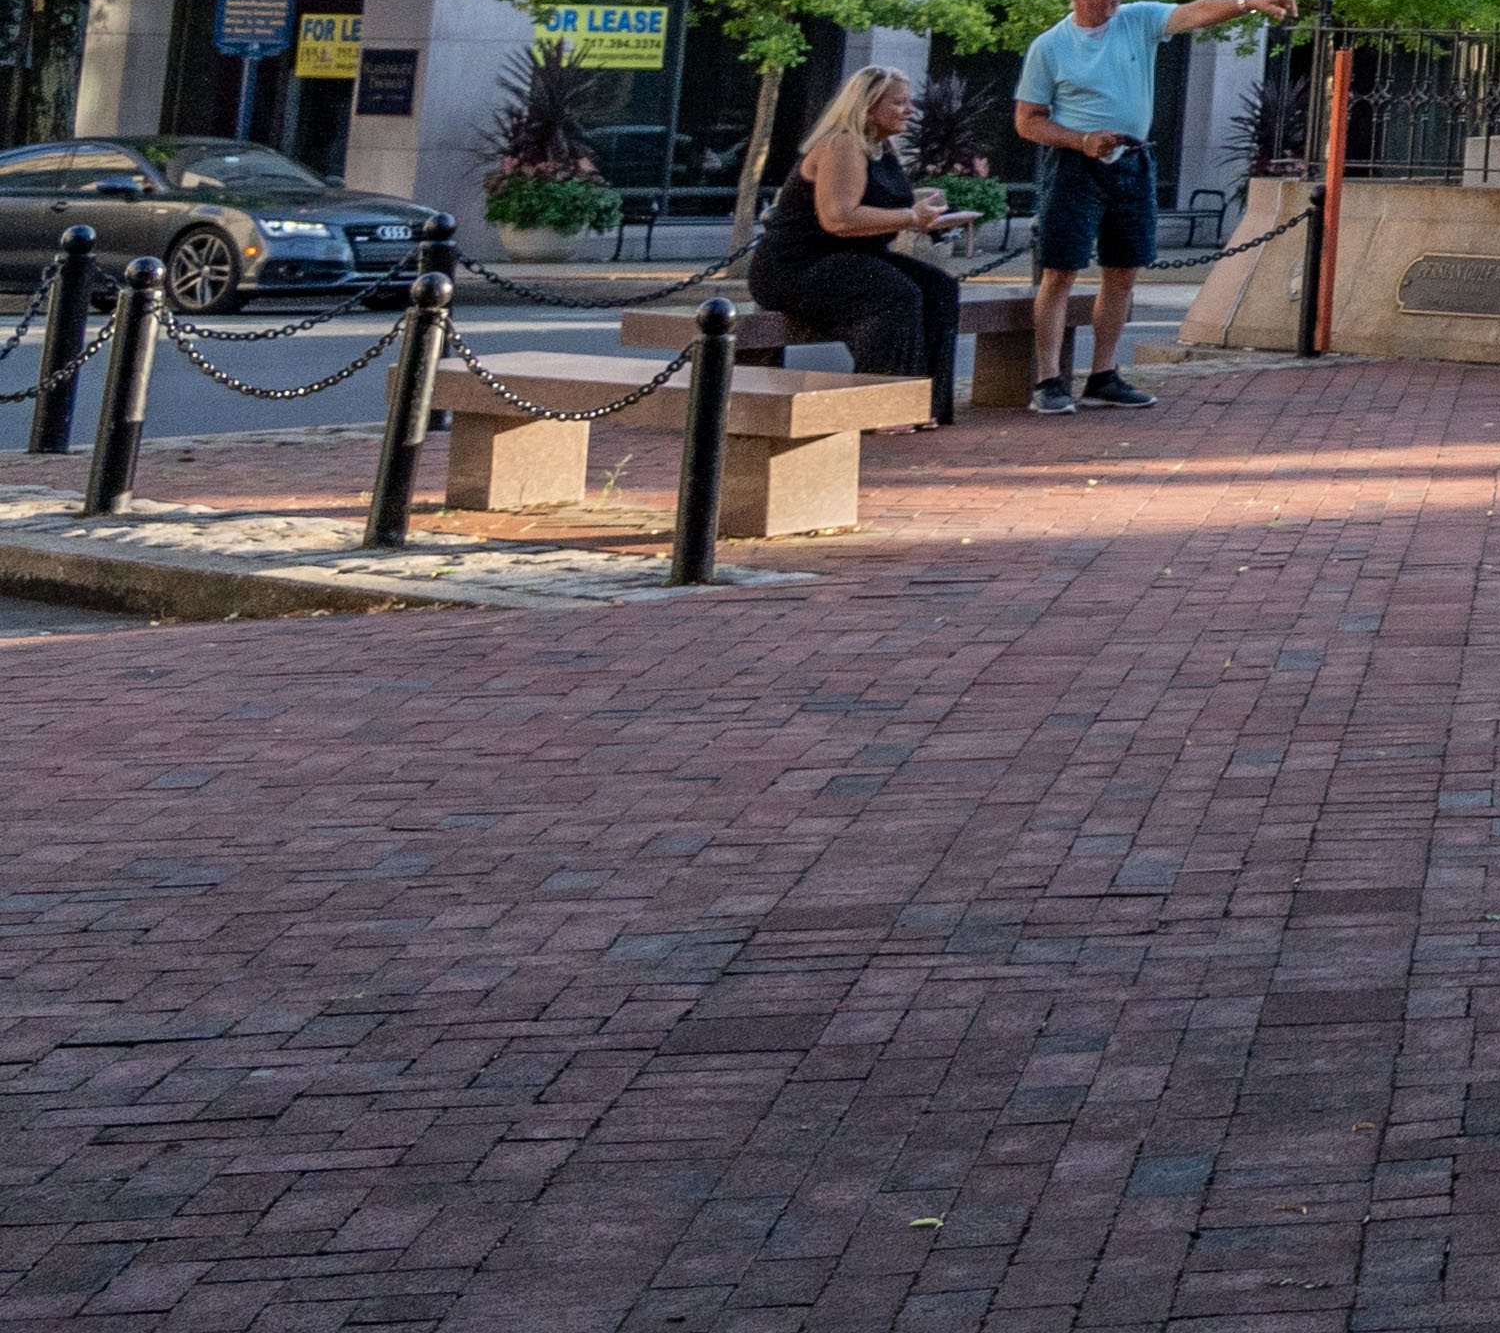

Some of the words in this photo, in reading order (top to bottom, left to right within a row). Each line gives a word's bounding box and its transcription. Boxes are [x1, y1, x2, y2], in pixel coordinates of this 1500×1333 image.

[302, 18, 336, 42] FOR
[546, 9, 578, 32] OR
[587, 9, 662, 33] LEASE
